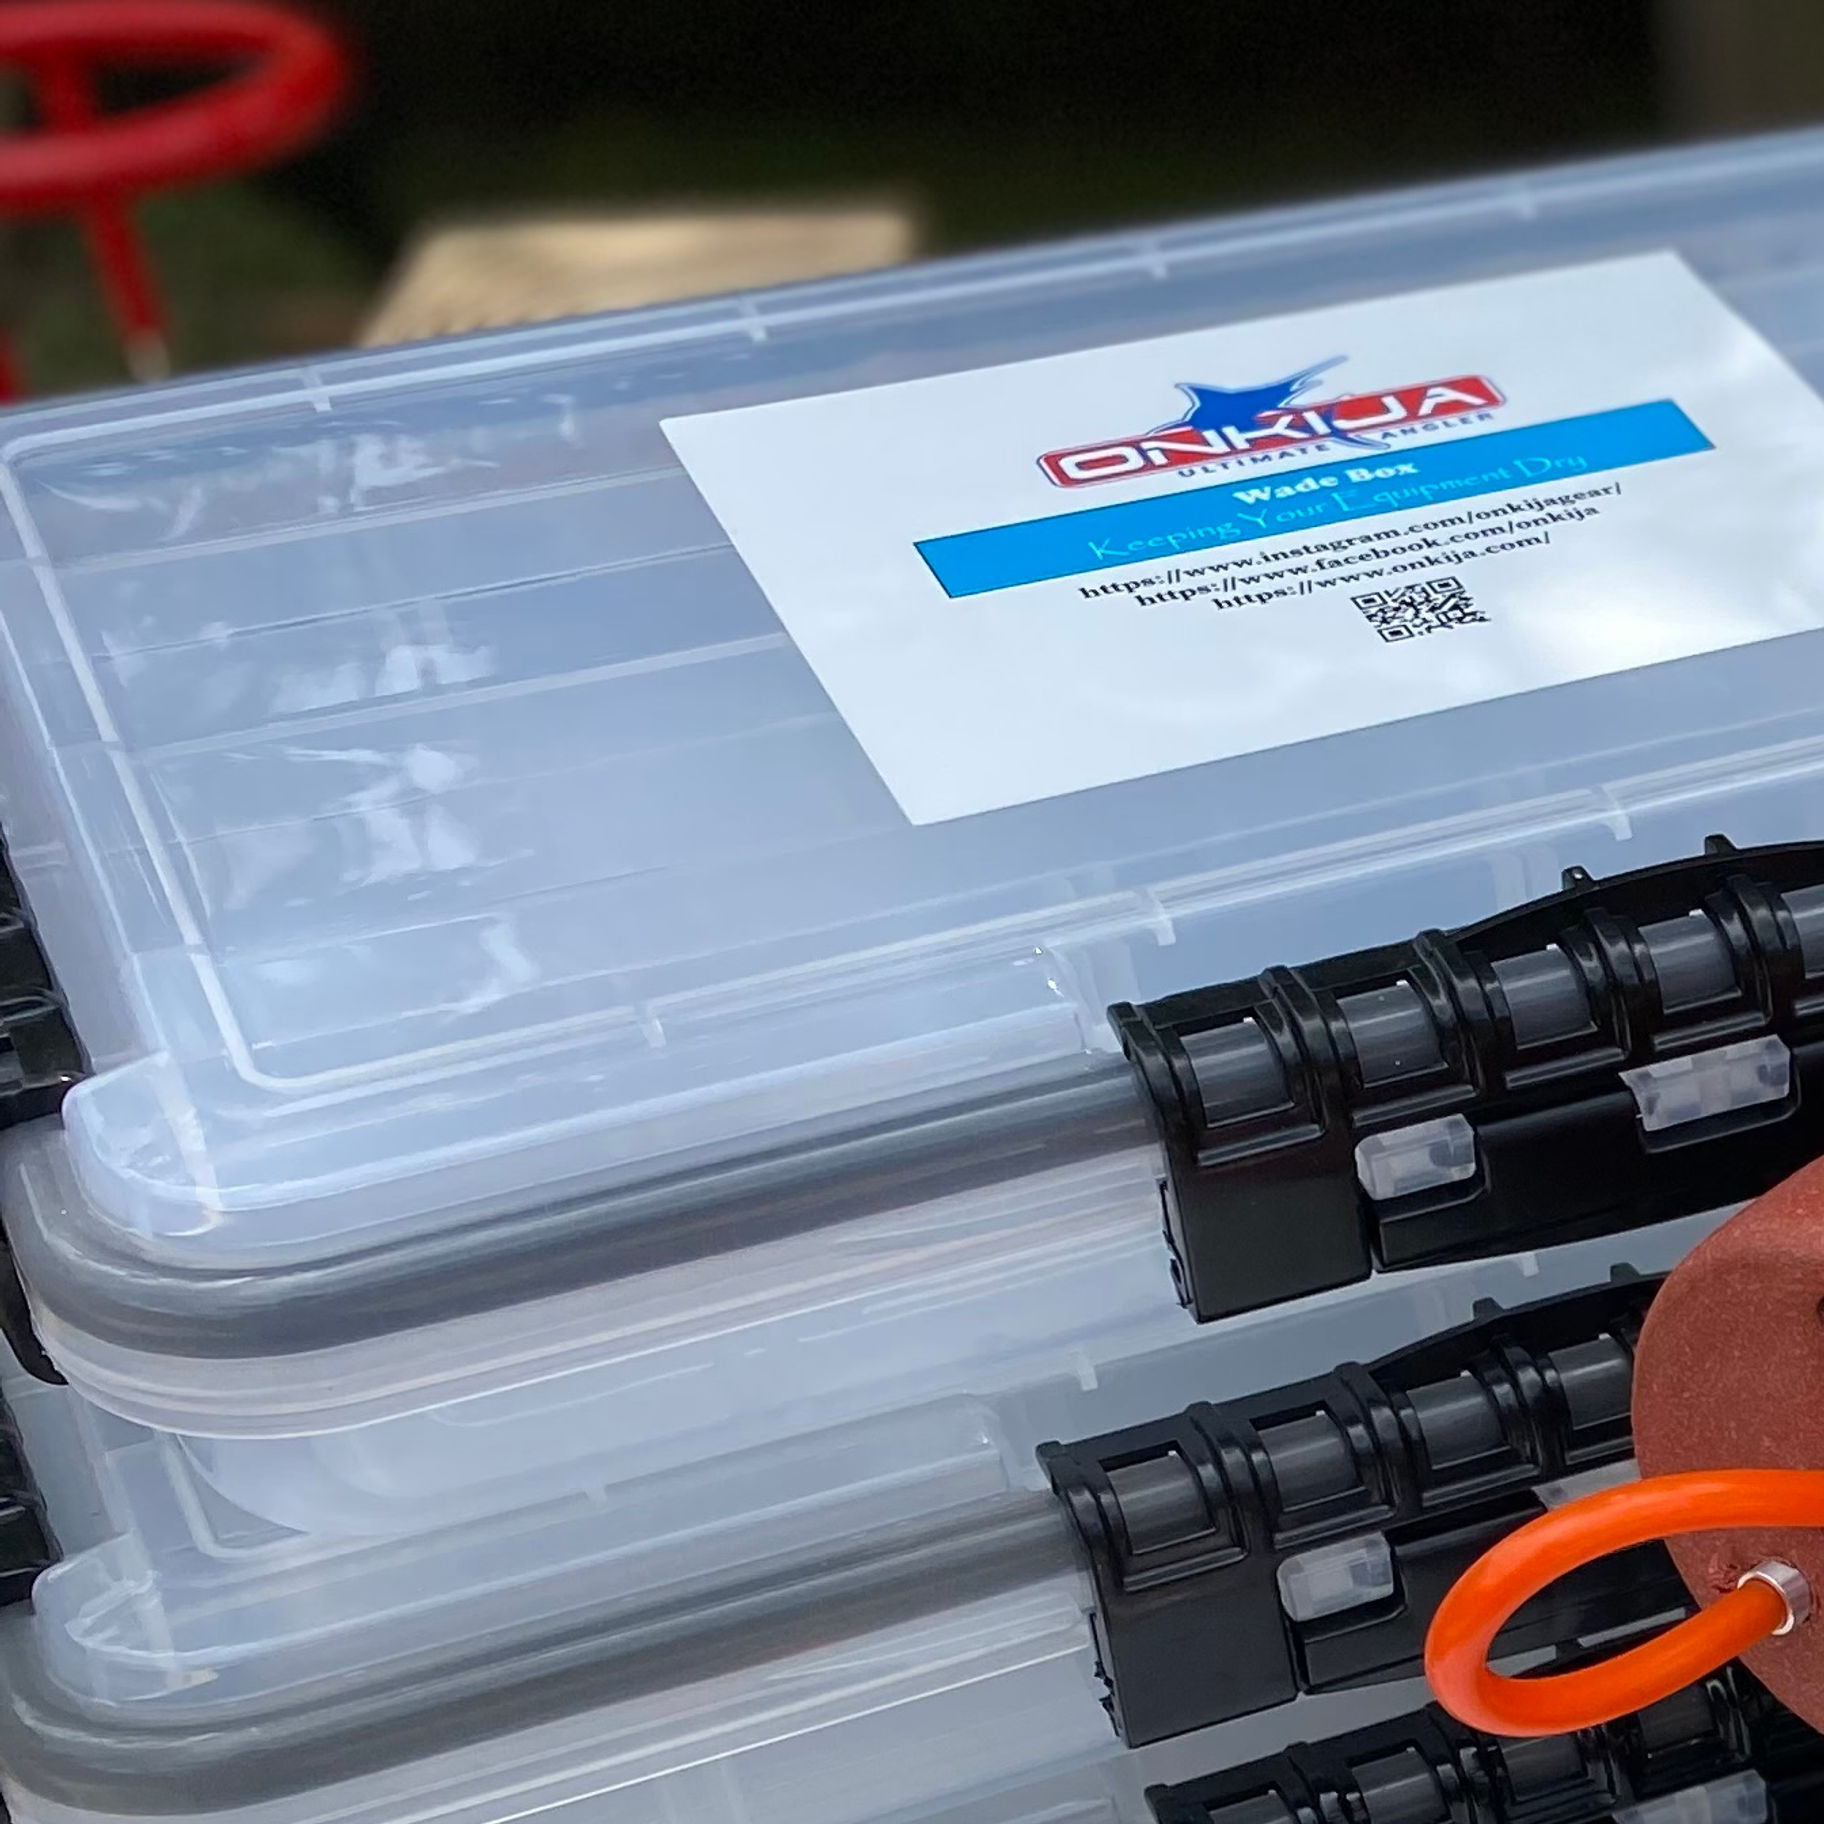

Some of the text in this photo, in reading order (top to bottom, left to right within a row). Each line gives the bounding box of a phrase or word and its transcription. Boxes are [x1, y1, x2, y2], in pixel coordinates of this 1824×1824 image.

[1058, 385, 1489, 481] ONKIJA
[1177, 412, 1496, 478] ULTIMATE ANGLER
[1087, 453, 1589, 561] Keeping Your Equipment Dry
[1231, 459, 1420, 506] Wade Box
[1135, 504, 1600, 609] https://www.facebook.com/onkija
[1213, 531, 1552, 612] https://www.onkija.com/
